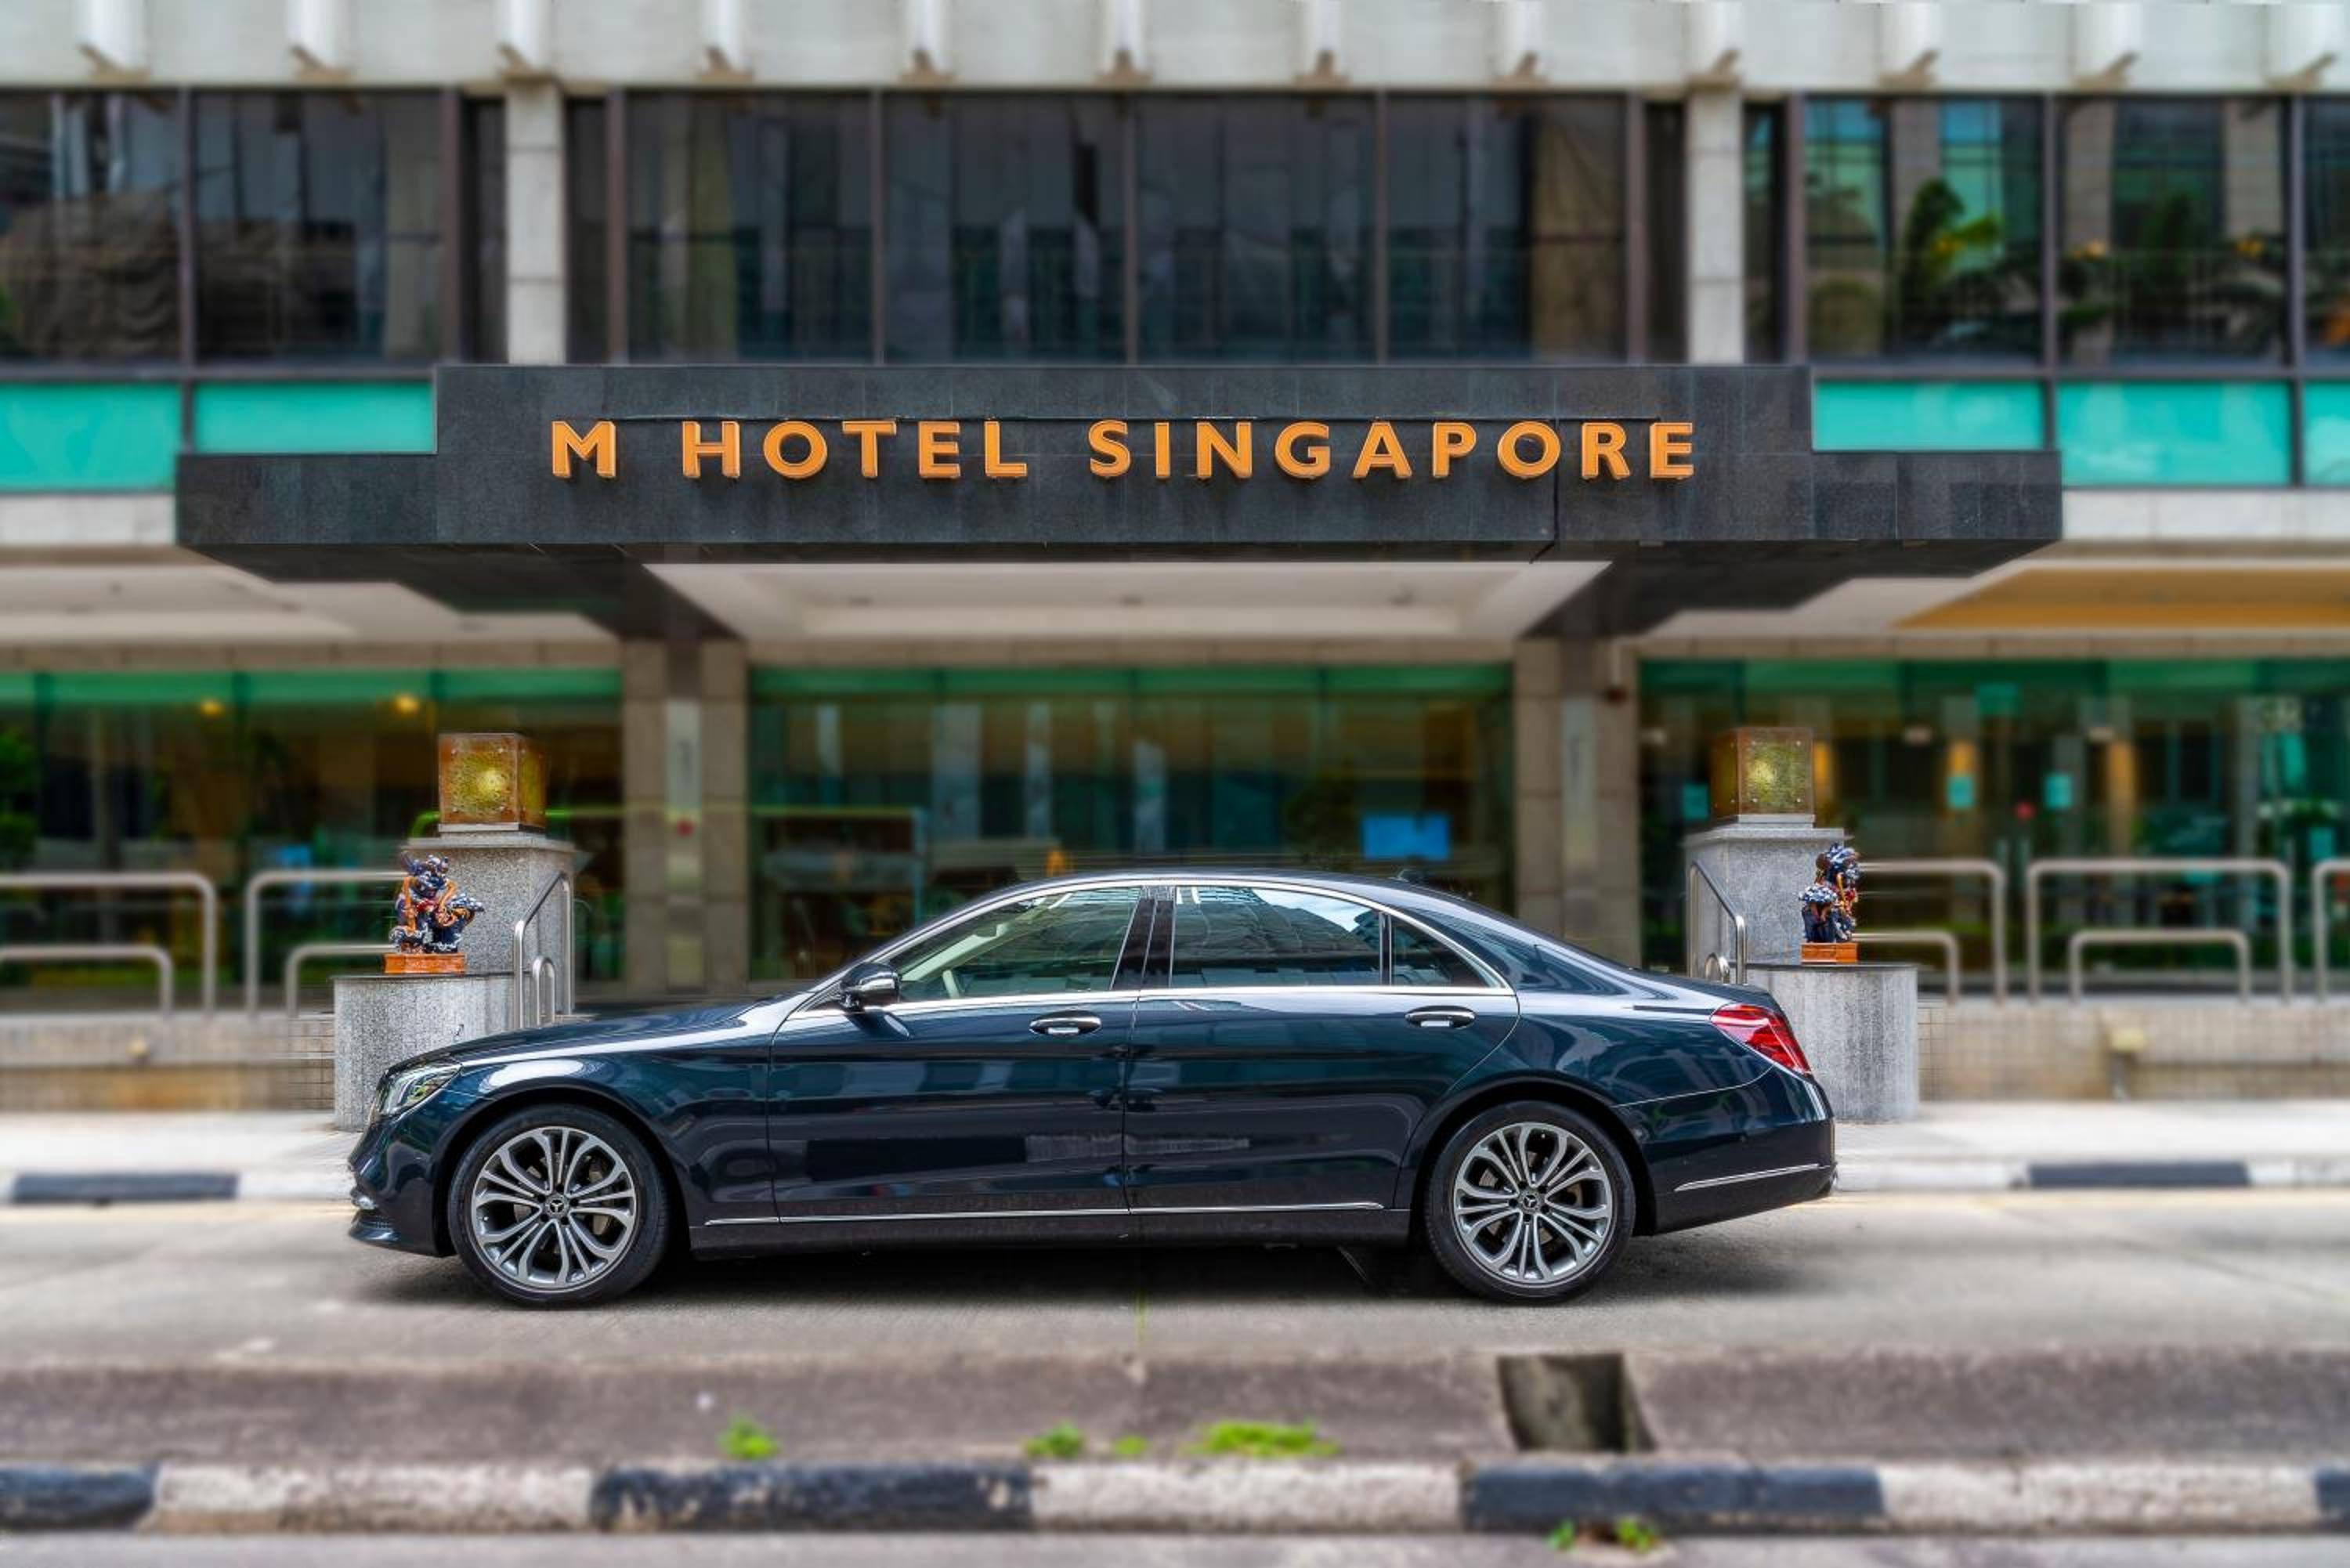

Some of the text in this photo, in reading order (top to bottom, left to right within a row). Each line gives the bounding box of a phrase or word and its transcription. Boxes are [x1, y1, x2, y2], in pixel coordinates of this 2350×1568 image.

[551, 420, 1694, 479] M HOTEL SINGAPORE
